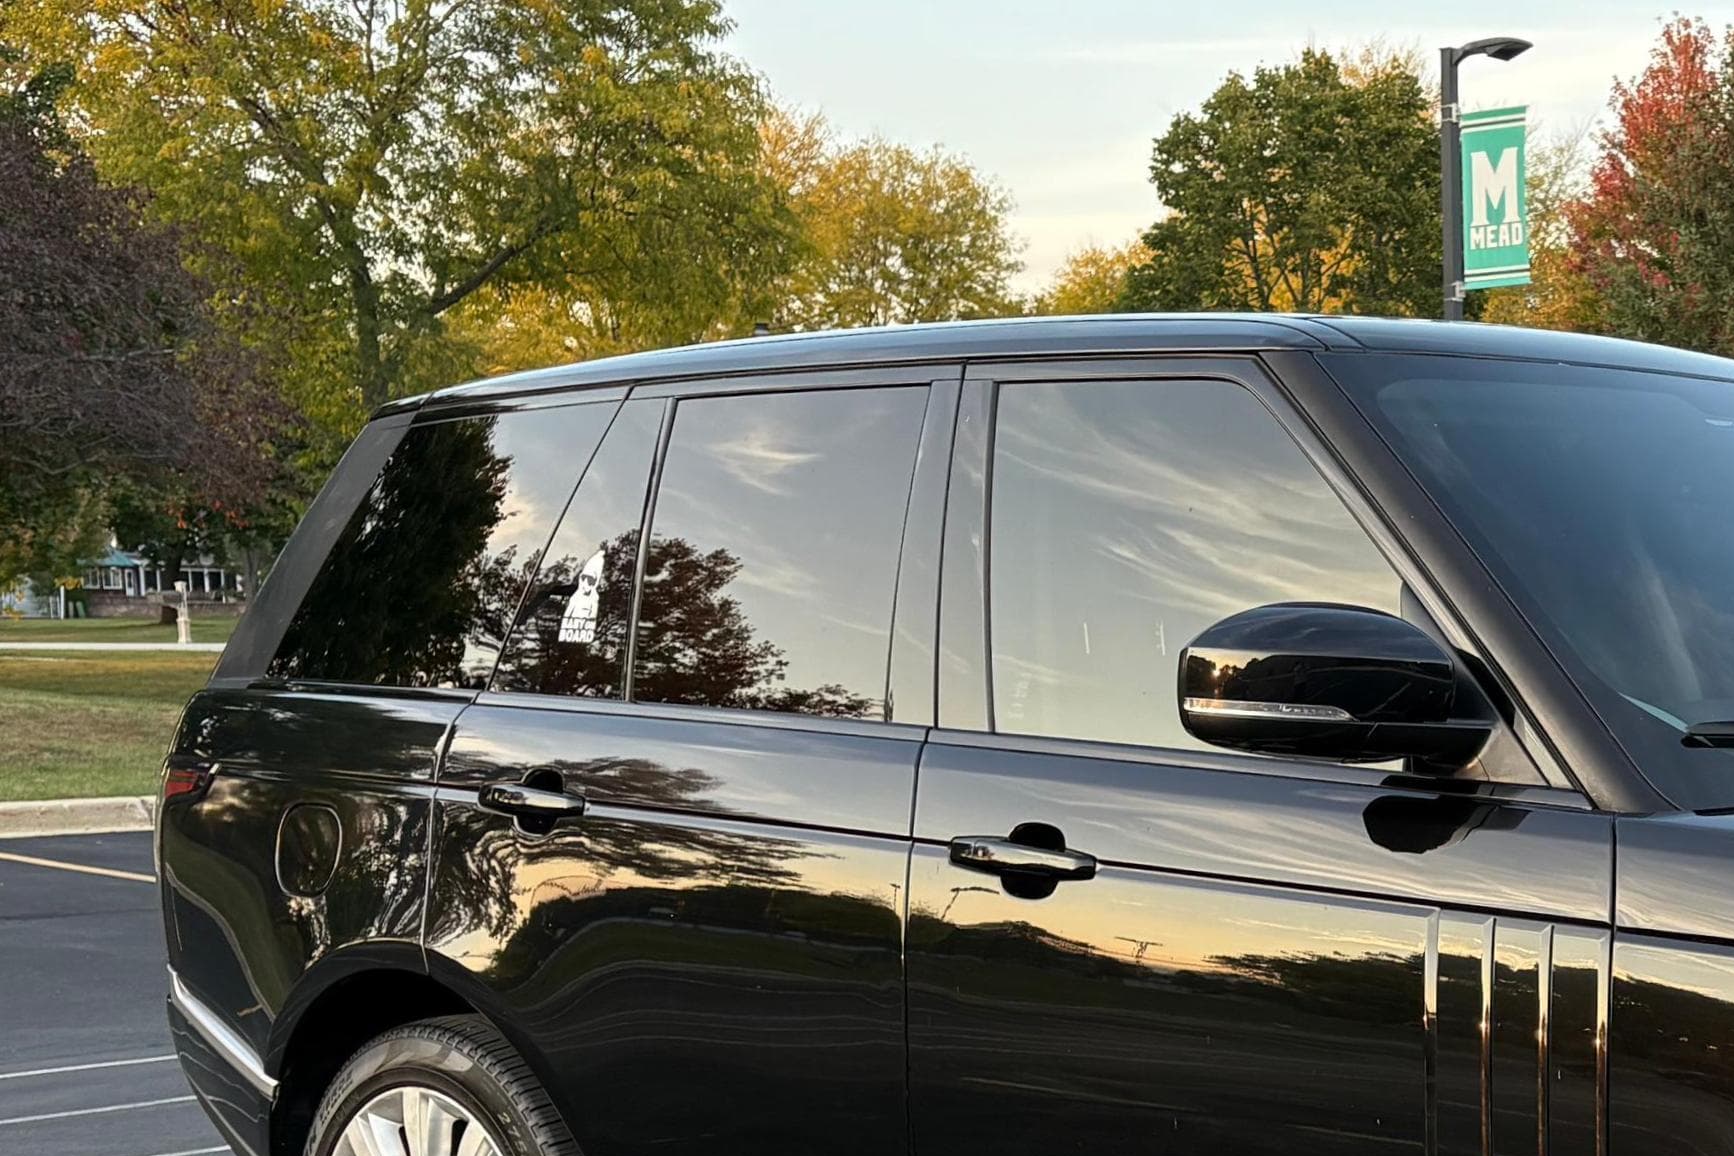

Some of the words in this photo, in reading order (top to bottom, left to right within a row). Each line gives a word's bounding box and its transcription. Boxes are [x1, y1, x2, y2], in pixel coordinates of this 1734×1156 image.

[1470, 146, 1521, 227] M
[1470, 223, 1524, 249] MEAD
[561, 617, 586, 630] BABY
[558, 629, 595, 643] BOARD
